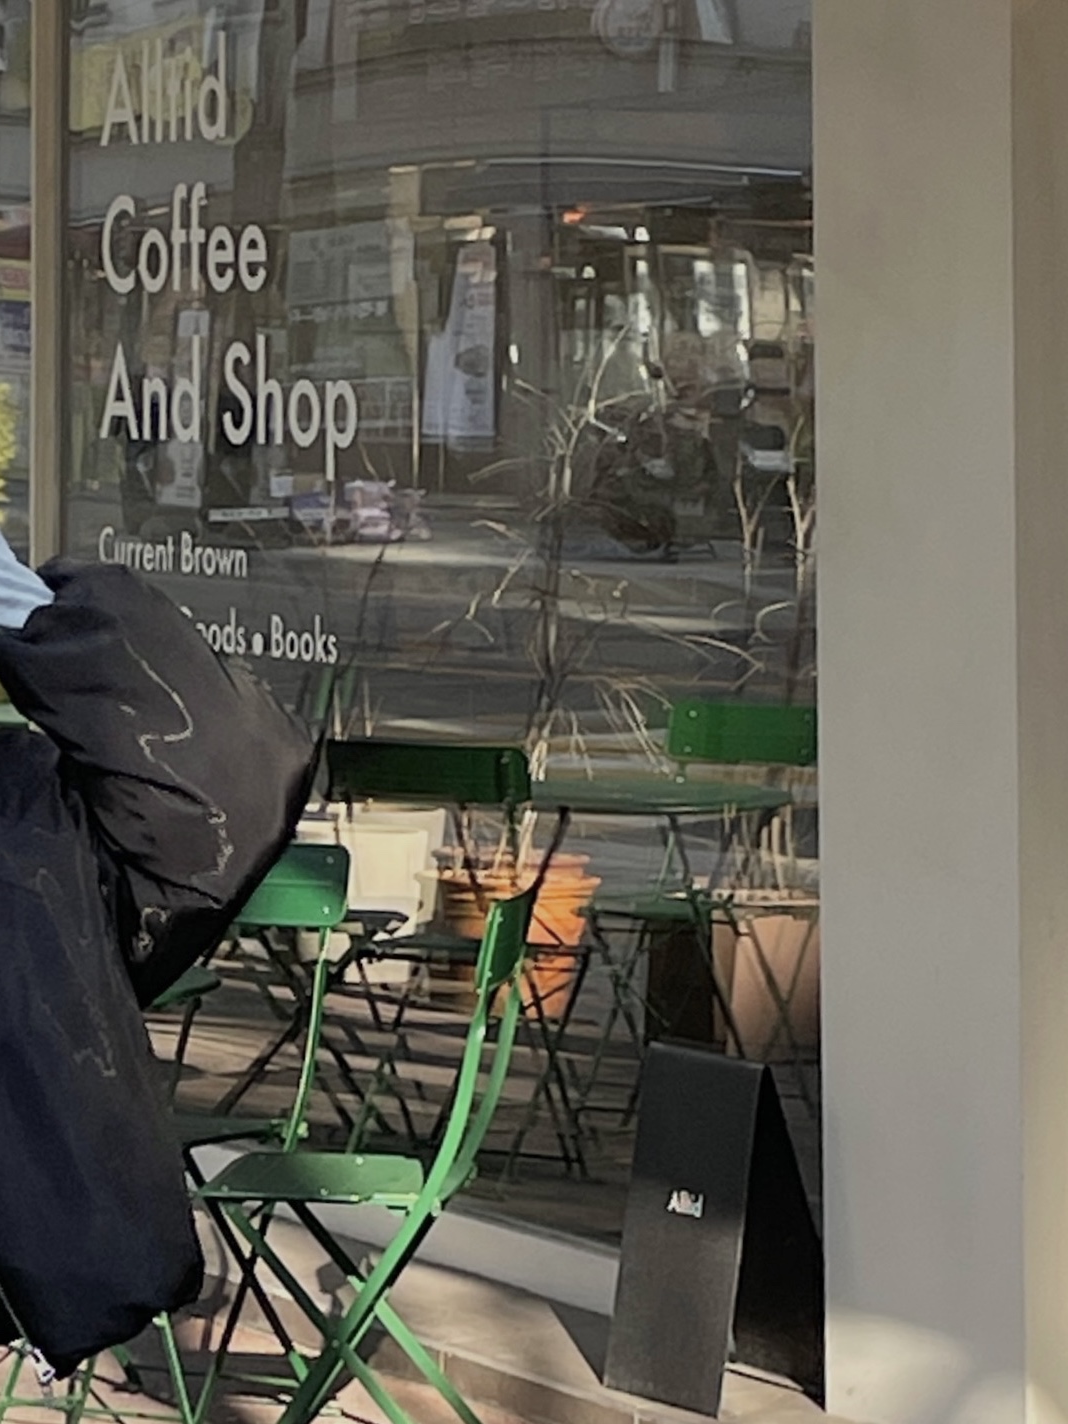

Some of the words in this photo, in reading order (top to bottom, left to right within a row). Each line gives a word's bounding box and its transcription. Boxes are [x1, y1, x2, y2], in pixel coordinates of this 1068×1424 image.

[102, 181, 268, 294] Coffee
[100, 342, 200, 443] And
[222, 333, 358, 482] Shop
[99, 526, 174, 573] Current
[181, 530, 248, 578] Brown
[180, 605, 247, 655] ods
[270, 614, 338, 664] Books
